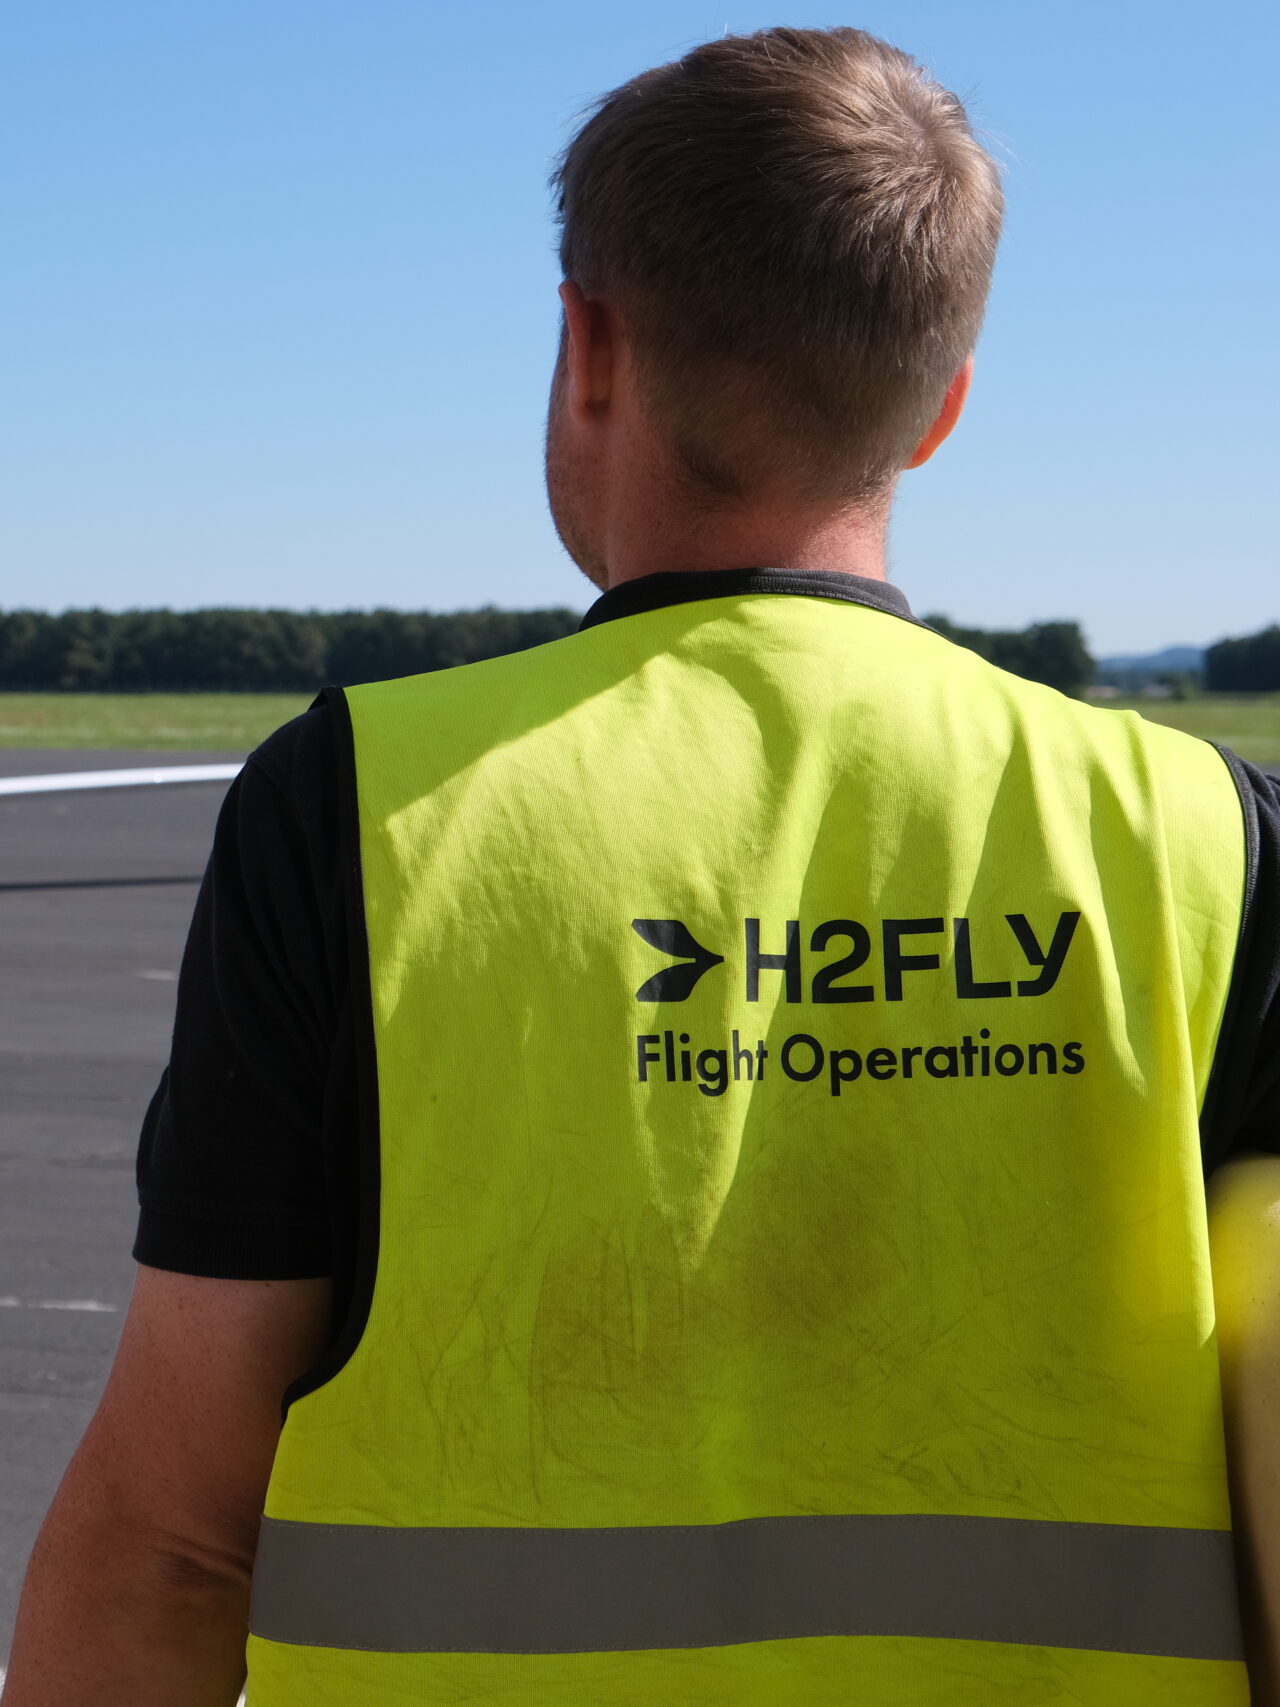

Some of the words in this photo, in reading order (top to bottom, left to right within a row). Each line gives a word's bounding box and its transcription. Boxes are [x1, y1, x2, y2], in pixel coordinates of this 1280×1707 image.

[745, 911, 1082, 1004] H2FLY
[636, 1030, 769, 1097] Flight
[780, 1028, 1086, 1097] Operations
